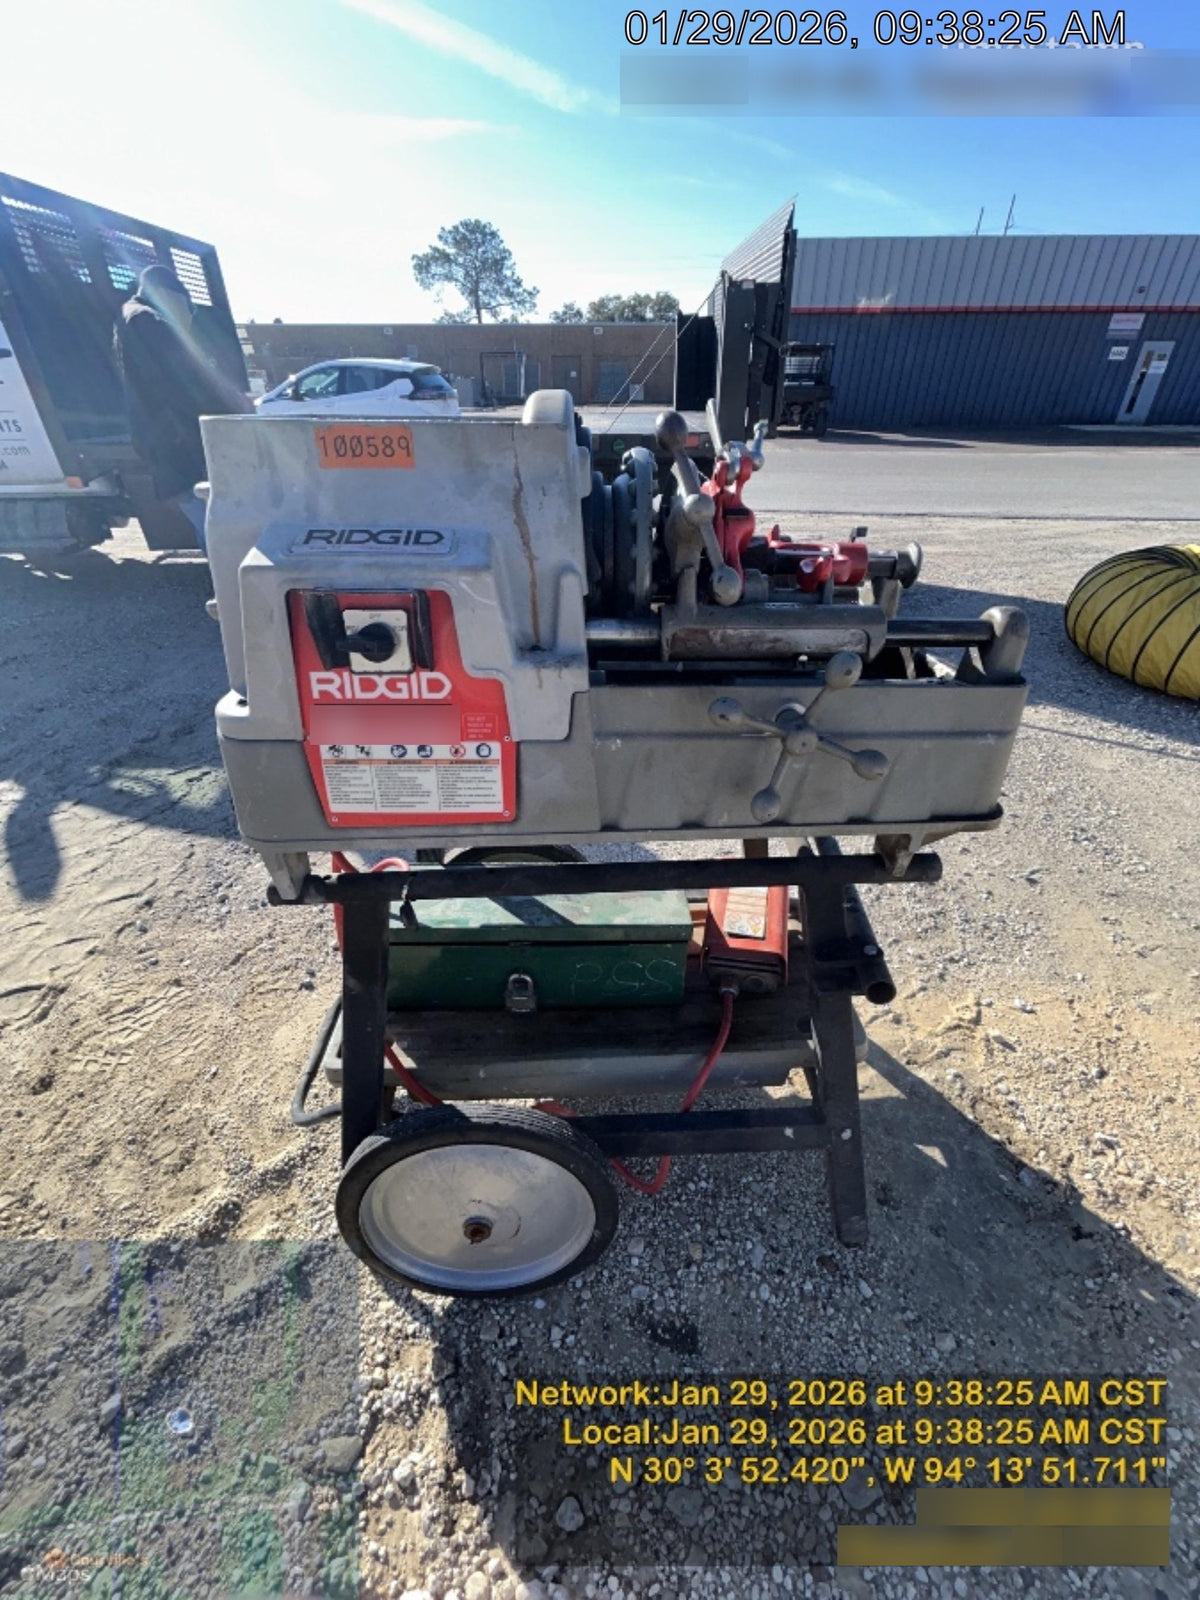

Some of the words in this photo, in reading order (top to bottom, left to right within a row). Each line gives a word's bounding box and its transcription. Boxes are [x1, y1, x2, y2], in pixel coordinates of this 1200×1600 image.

[319, 434, 412, 459] 100589
[302, 528, 447, 547] RIDGID
[308, 670, 453, 700] RIDGID
